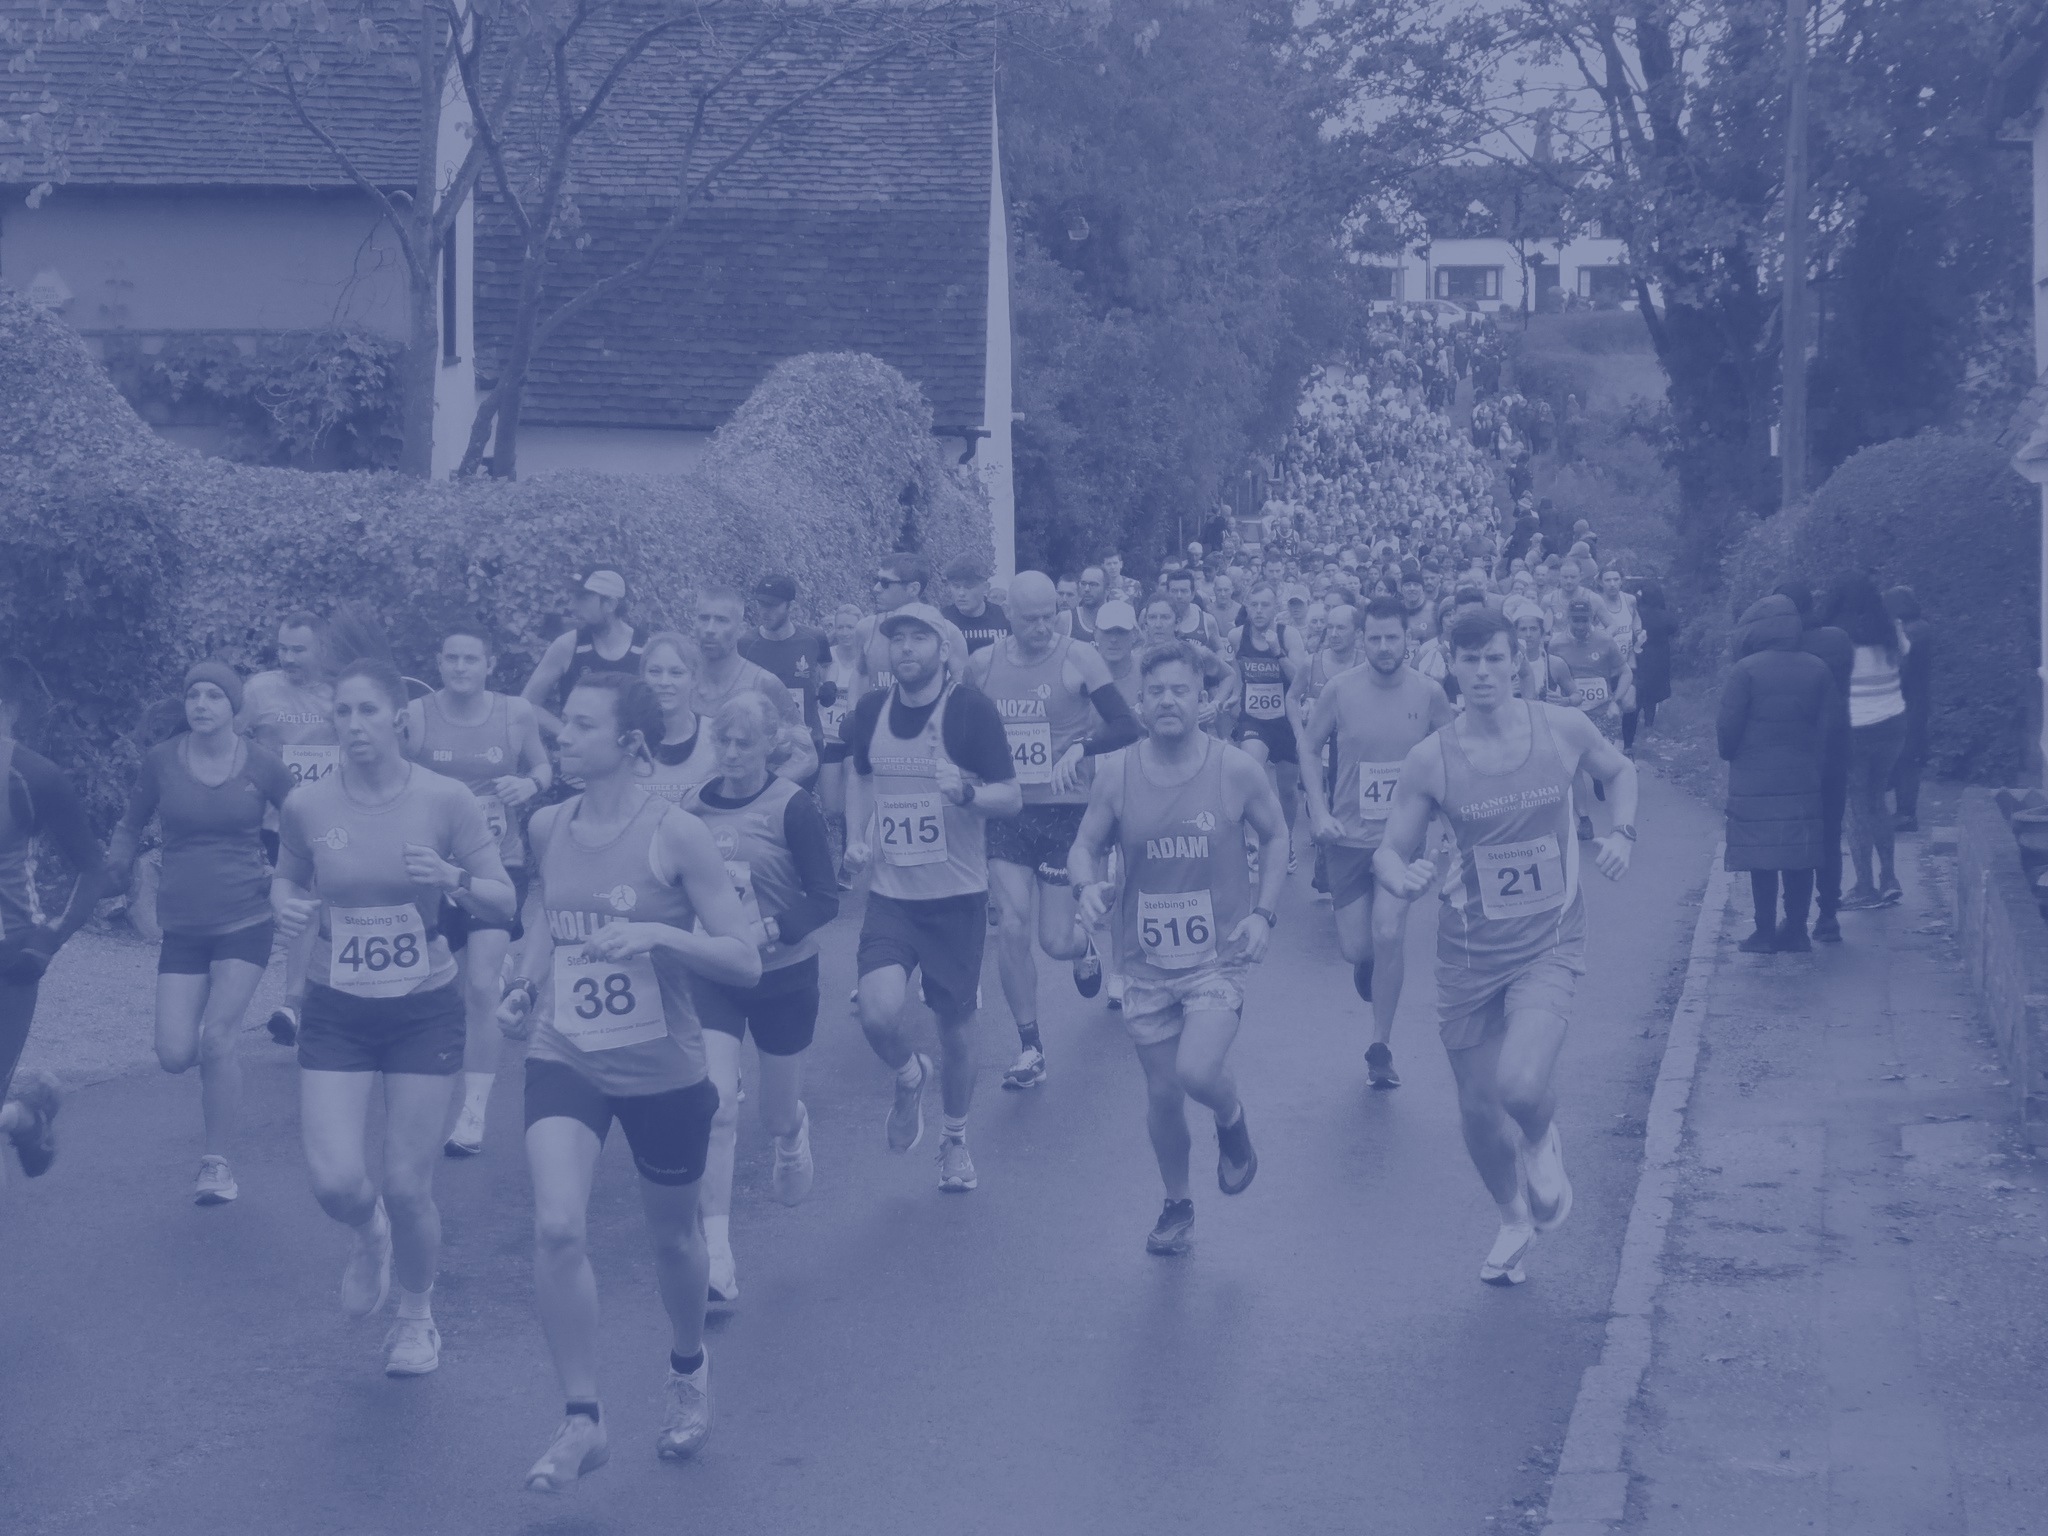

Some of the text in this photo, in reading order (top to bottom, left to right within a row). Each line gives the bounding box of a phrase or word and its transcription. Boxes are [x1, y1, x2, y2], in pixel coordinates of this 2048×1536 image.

[1244, 662, 1280, 672] VEGAN
[1248, 695, 1282, 710] 266
[1579, 688, 1605, 701] 269
[277, 710, 301, 724] Aon
[996, 699, 1047, 718] NOZZA
[1006, 729, 1031, 737] ebbing
[292, 750, 324, 758] Stebbing
[432, 750, 453, 762] BEN
[1011, 742, 1047, 766] 48
[1364, 779, 1398, 803] 47
[1460, 785, 1561, 814] GRANGE FARM
[883, 800, 930, 810] Stebbing 10
[1472, 804, 1519, 820] Dunmow
[1521, 796, 1561, 810] Runners
[882, 815, 940, 845] 215
[1146, 836, 1210, 860] ADAM
[1487, 844, 1547, 861] Stebbing 10
[1497, 863, 1542, 896] 21
[1144, 899, 1198, 910] Stebbing 10
[344, 913, 409, 926] Stebbing 10
[546, 909, 630, 941] HOLL
[1143, 915, 1210, 948] 516
[338, 932, 421, 972] 468
[573, 972, 636, 1020] 38
